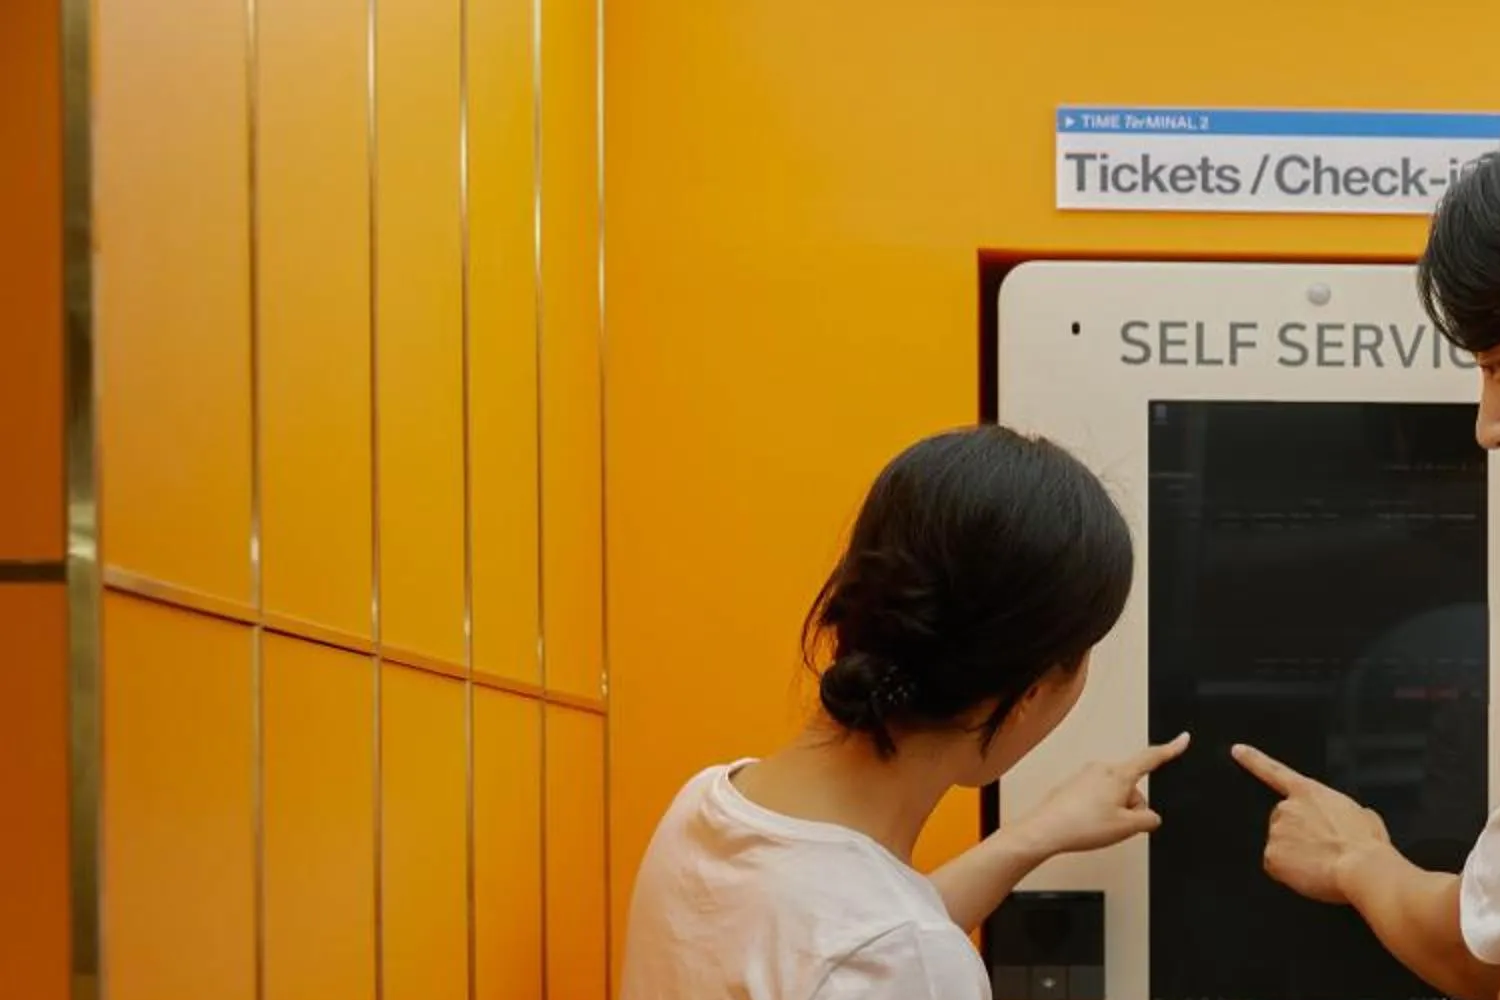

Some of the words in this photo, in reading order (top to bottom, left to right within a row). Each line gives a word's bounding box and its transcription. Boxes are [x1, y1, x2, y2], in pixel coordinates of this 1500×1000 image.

[1081, 115, 1120, 129] TIME
[1200, 115, 1210, 130] 2
[1274, 154, 1460, 197] Check-i
[1120, 320, 1259, 367] SELF
